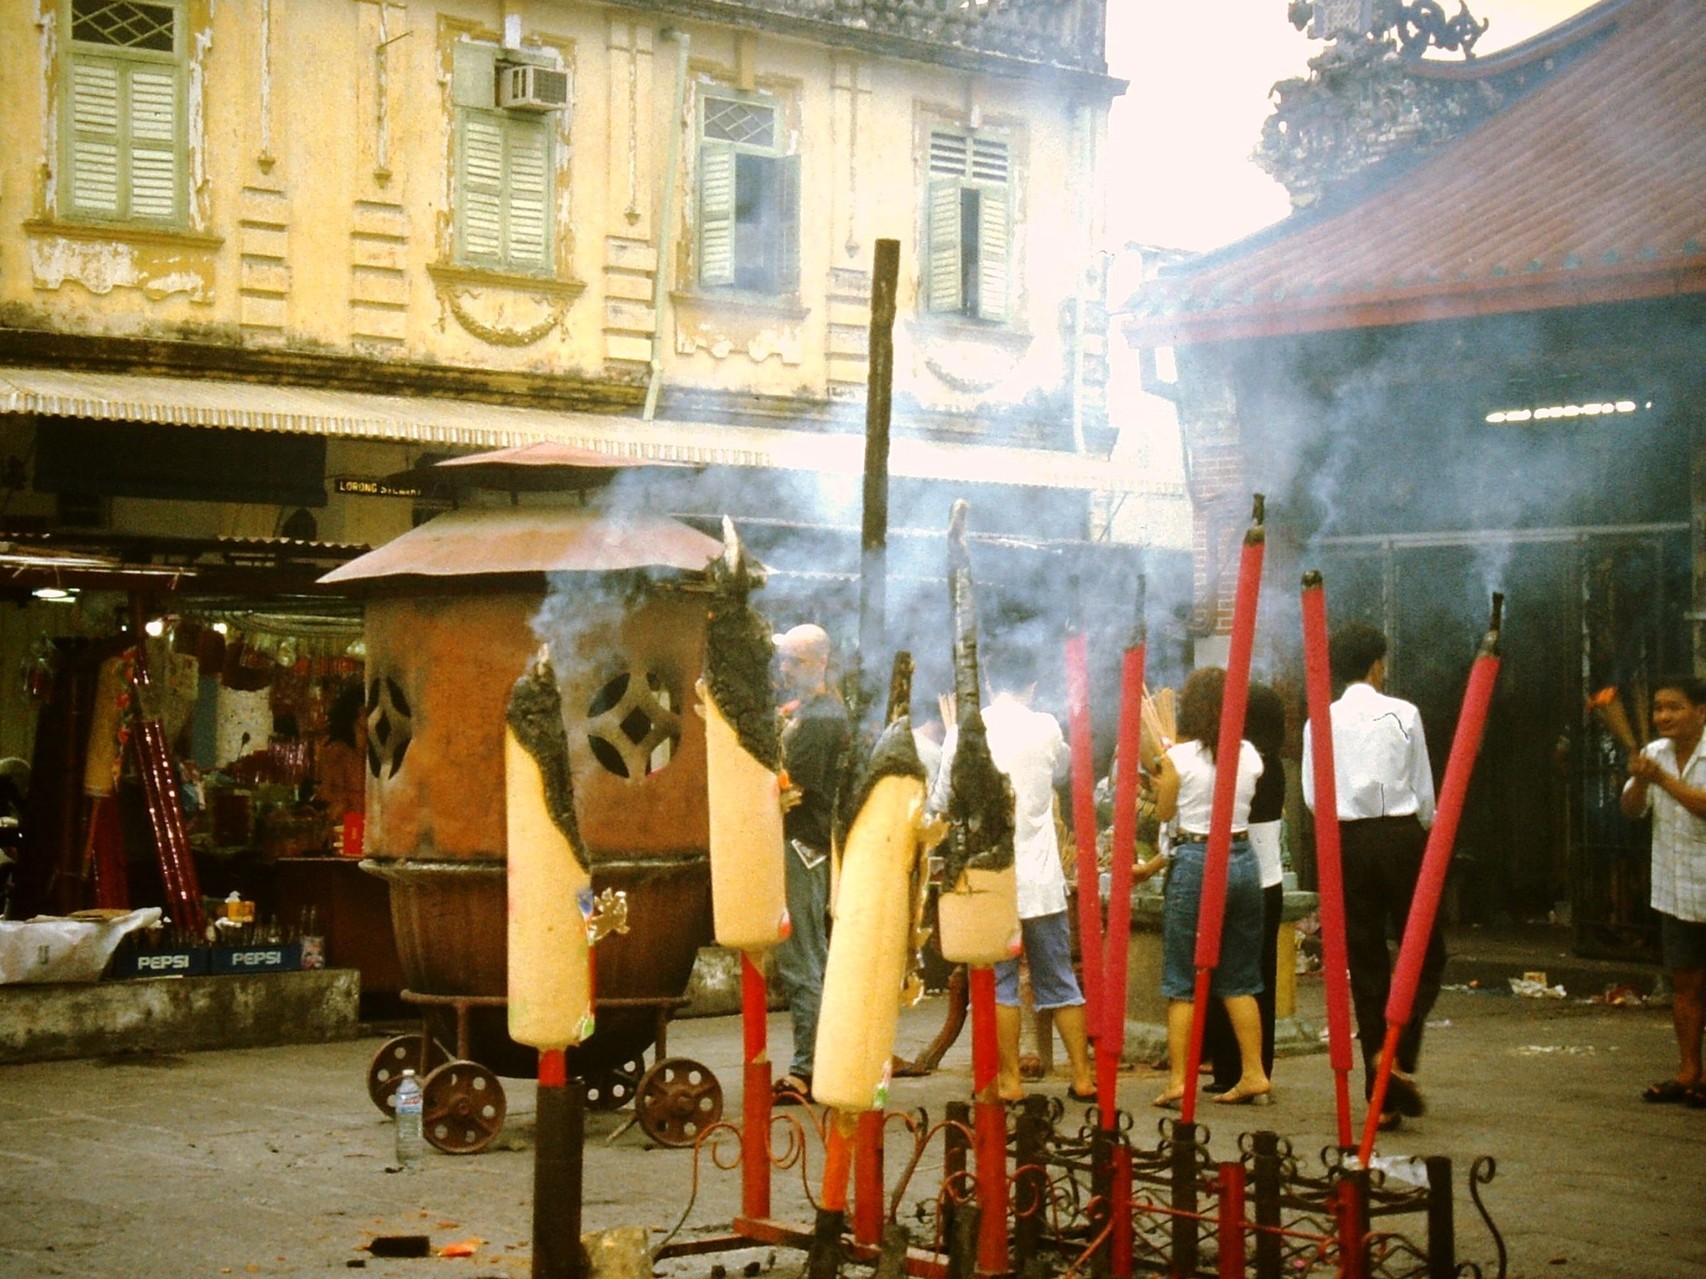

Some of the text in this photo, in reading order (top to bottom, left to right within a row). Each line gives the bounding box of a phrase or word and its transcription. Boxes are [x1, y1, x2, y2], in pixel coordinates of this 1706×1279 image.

[340, 481, 377, 493] LORONG
[138, 955, 189, 970] PEPSI
[232, 951, 281, 966] PEPSI
